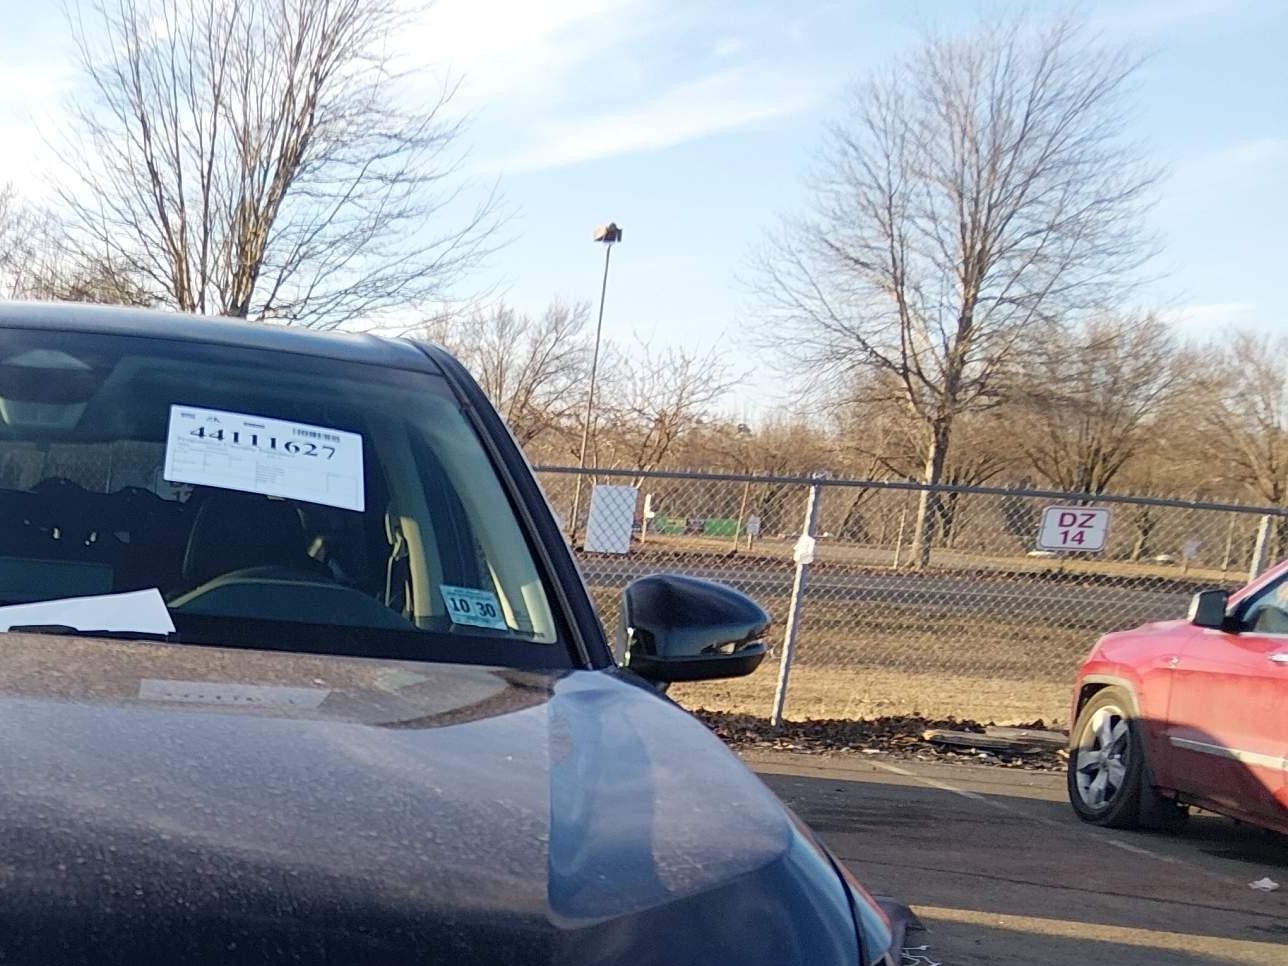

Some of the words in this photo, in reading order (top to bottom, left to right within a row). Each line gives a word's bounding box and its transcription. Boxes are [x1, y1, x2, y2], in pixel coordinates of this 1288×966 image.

[190, 421, 336, 460] 44111627
[1058, 512, 1097, 528] DZ
[1059, 530, 1085, 545] 14
[475, 601, 497, 618] 30
